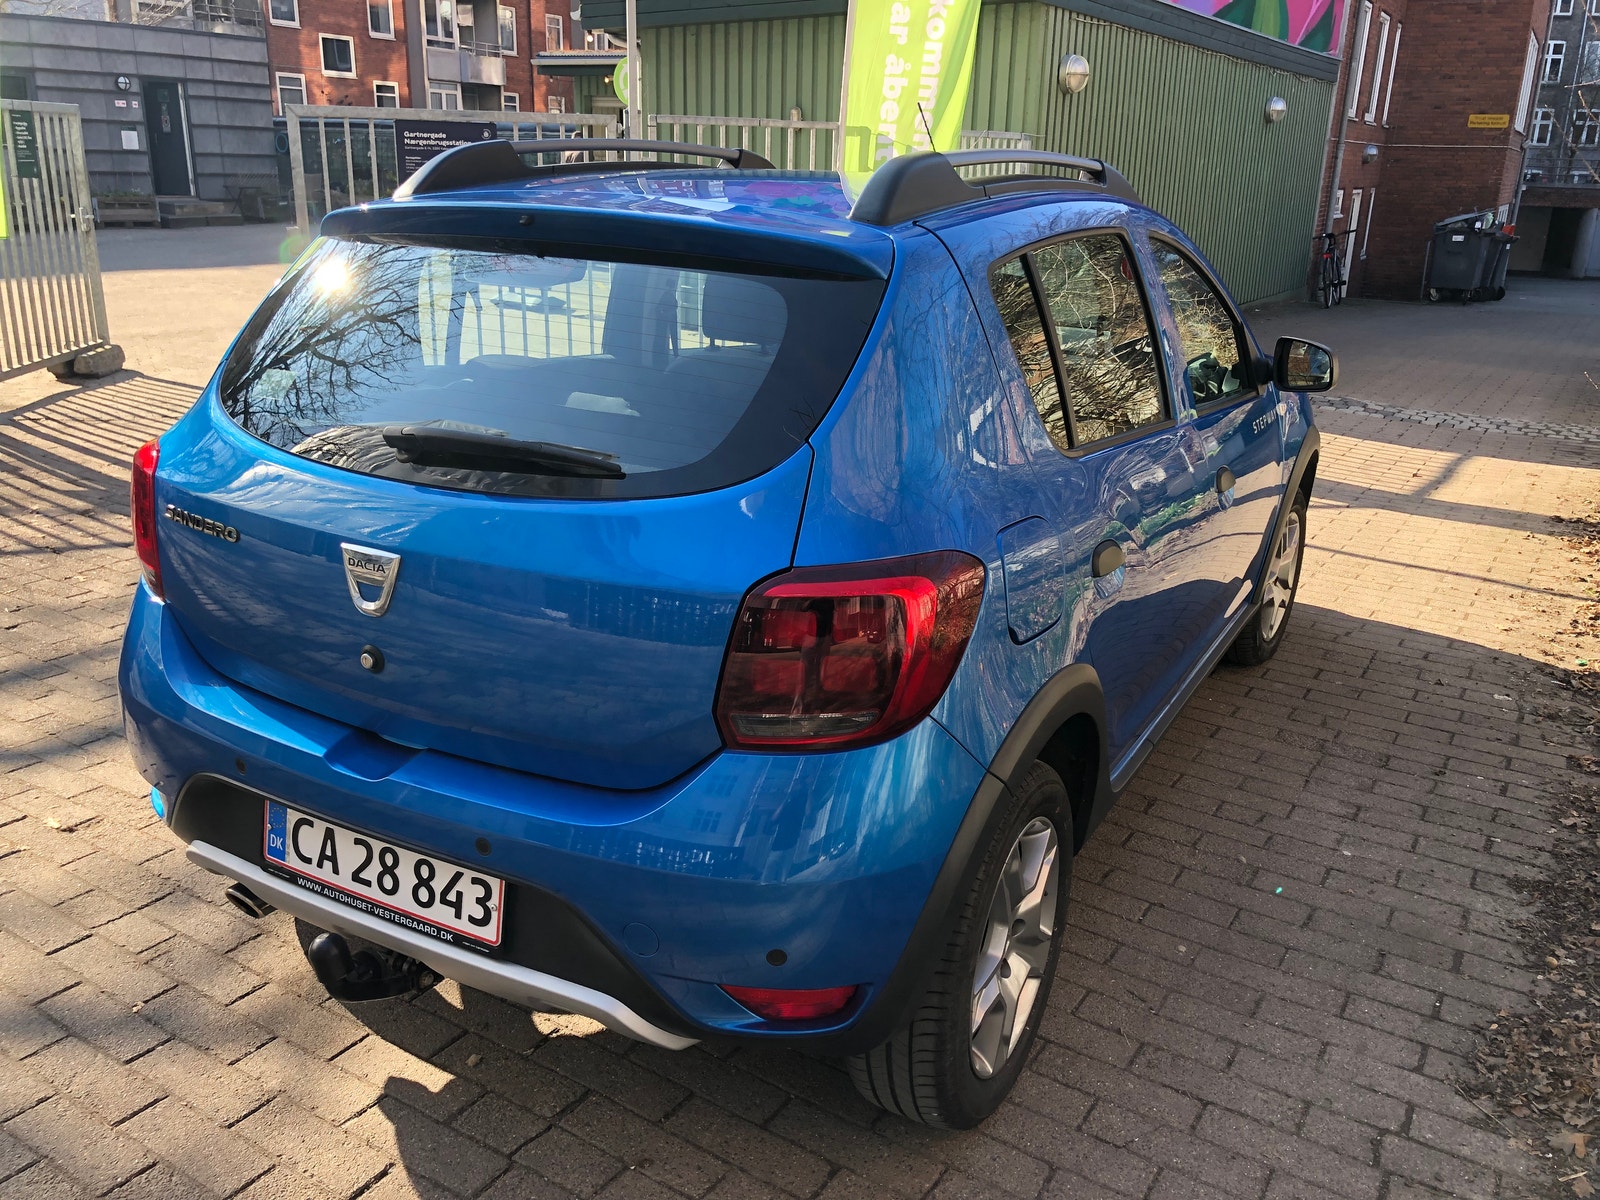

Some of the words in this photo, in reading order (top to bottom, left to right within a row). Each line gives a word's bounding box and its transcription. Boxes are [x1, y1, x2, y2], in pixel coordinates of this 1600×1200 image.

[403, 131, 447, 139] Gartnergade
[164, 503, 240, 543] SANDERO
[348, 557, 386, 574] DACIA
[270, 833, 284, 851] DK
[291, 817, 340, 876] CA
[351, 837, 400, 896] 28
[411, 858, 493, 928] 843
[297, 876, 454, 943] WWW.AUTOHUSET-VESTERGAARD.DK
